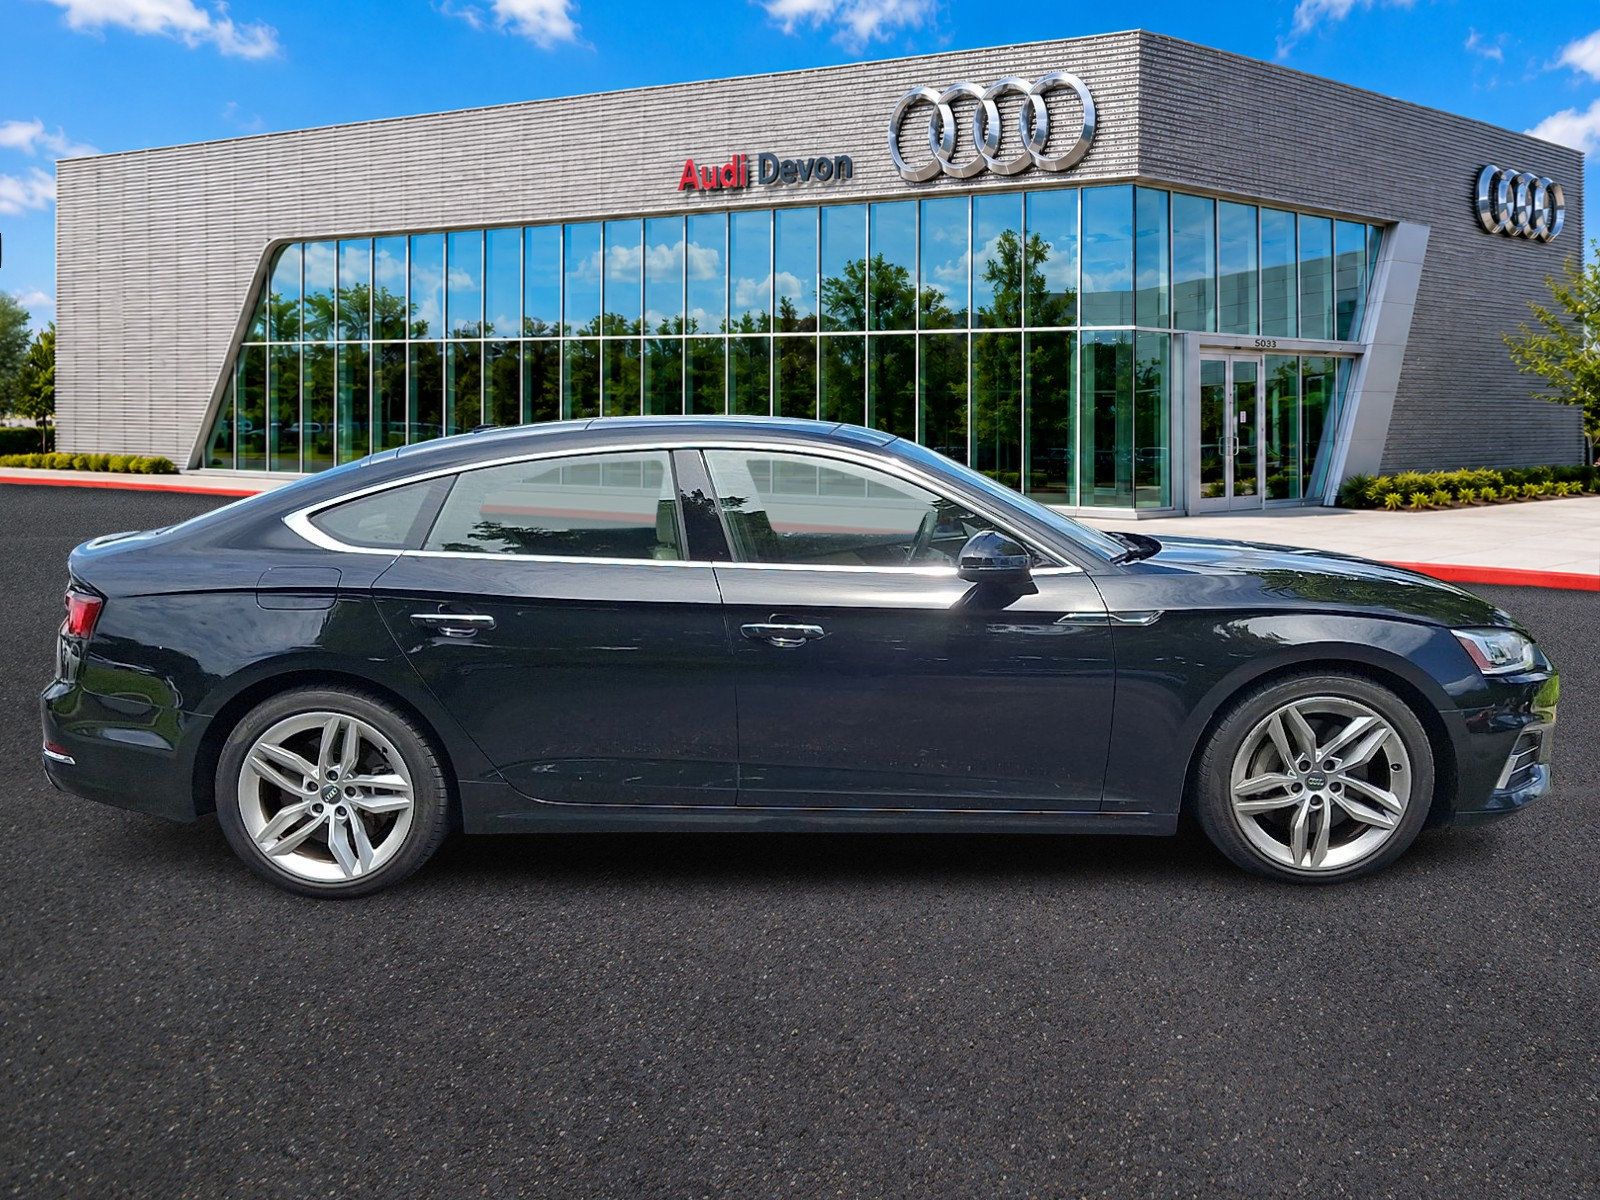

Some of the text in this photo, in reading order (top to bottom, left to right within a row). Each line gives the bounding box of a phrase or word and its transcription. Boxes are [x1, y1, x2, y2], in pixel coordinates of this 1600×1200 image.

[677, 152, 853, 191] Audi Devon
[1255, 339, 1277, 348] 5033
